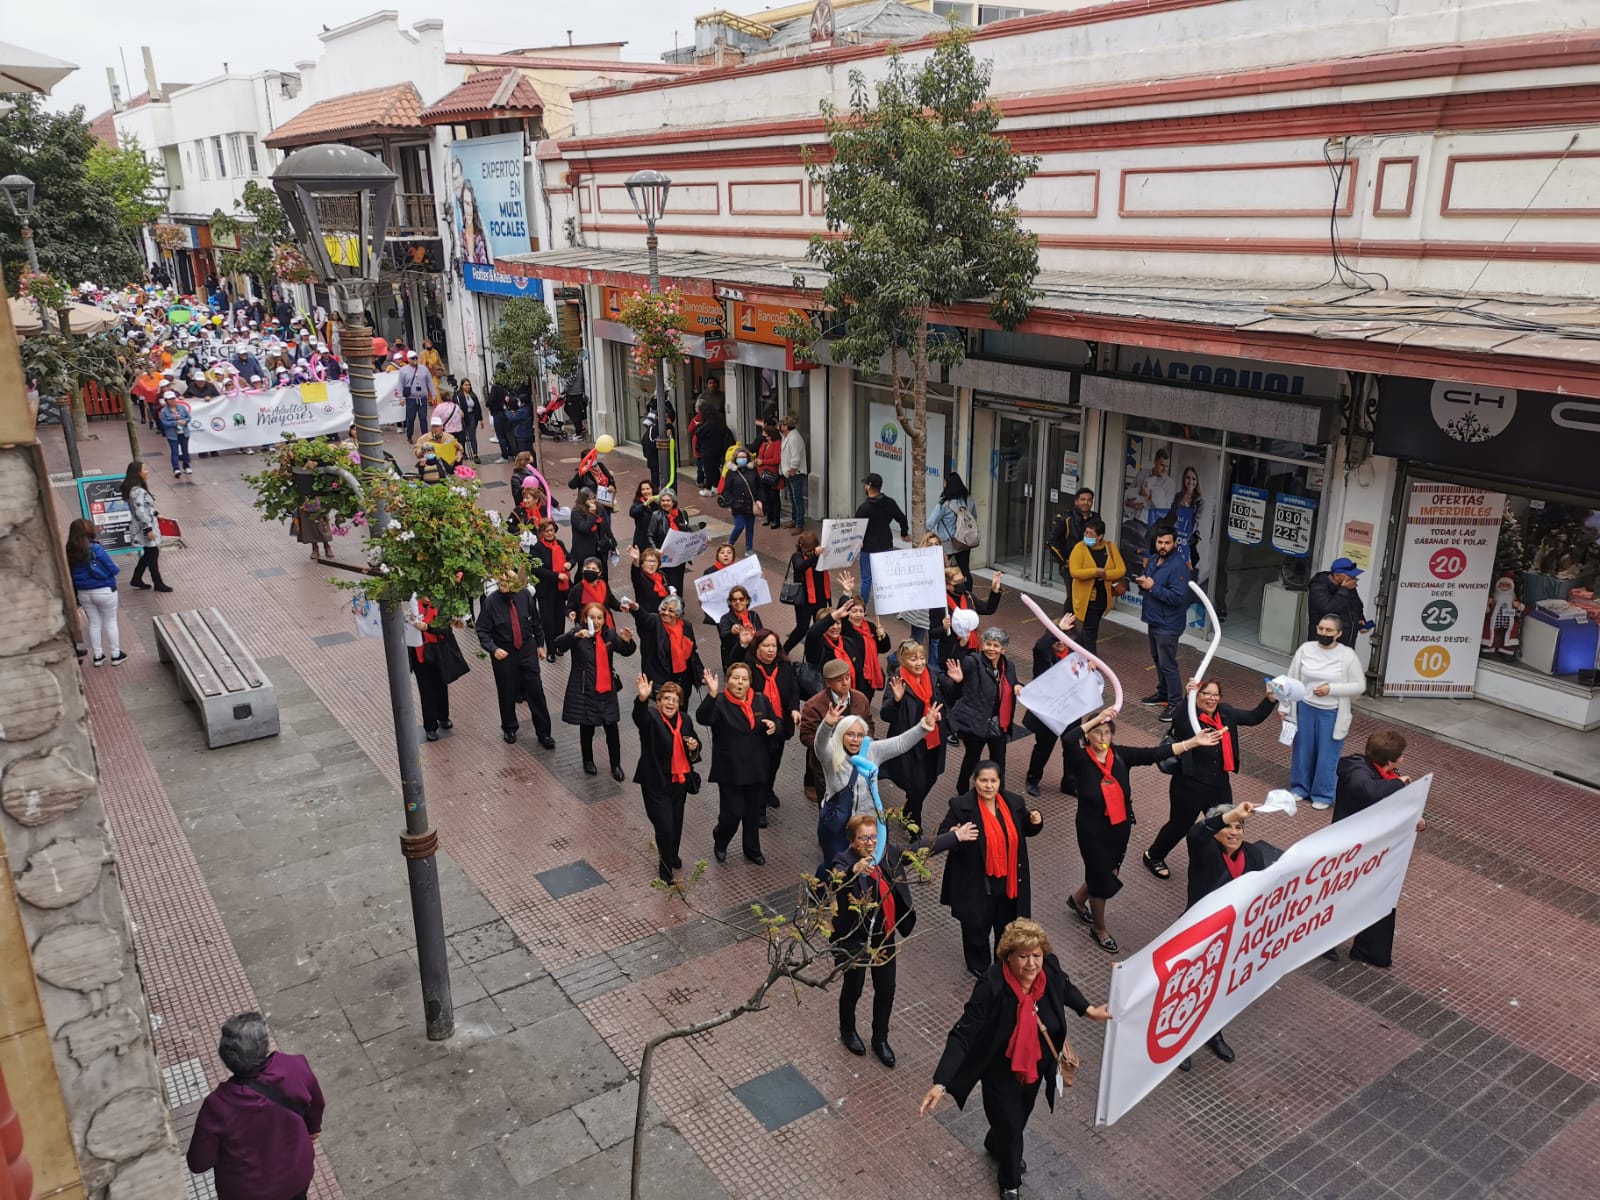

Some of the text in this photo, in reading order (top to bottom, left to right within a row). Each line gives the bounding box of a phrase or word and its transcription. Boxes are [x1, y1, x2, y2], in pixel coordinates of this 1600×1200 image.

[482, 159, 521, 178] EXPERTOS
[510, 180, 521, 197] EN
[499, 201, 523, 217] MULTI
[490, 221, 526, 237] FOCALES
[256, 410, 313, 427] Mayores
[1432, 495, 1485, 505] OFERTAS
[1420, 507, 1492, 516] IMPERDIBLES
[1414, 537, 1449, 545] SÁBANAS
[1400, 635, 1442, 643] FRAZADAS
[1243, 843, 1363, 928] Gran Coro
[1232, 848, 1390, 964] Adulto Mayor
[1226, 904, 1334, 996] La Serena
